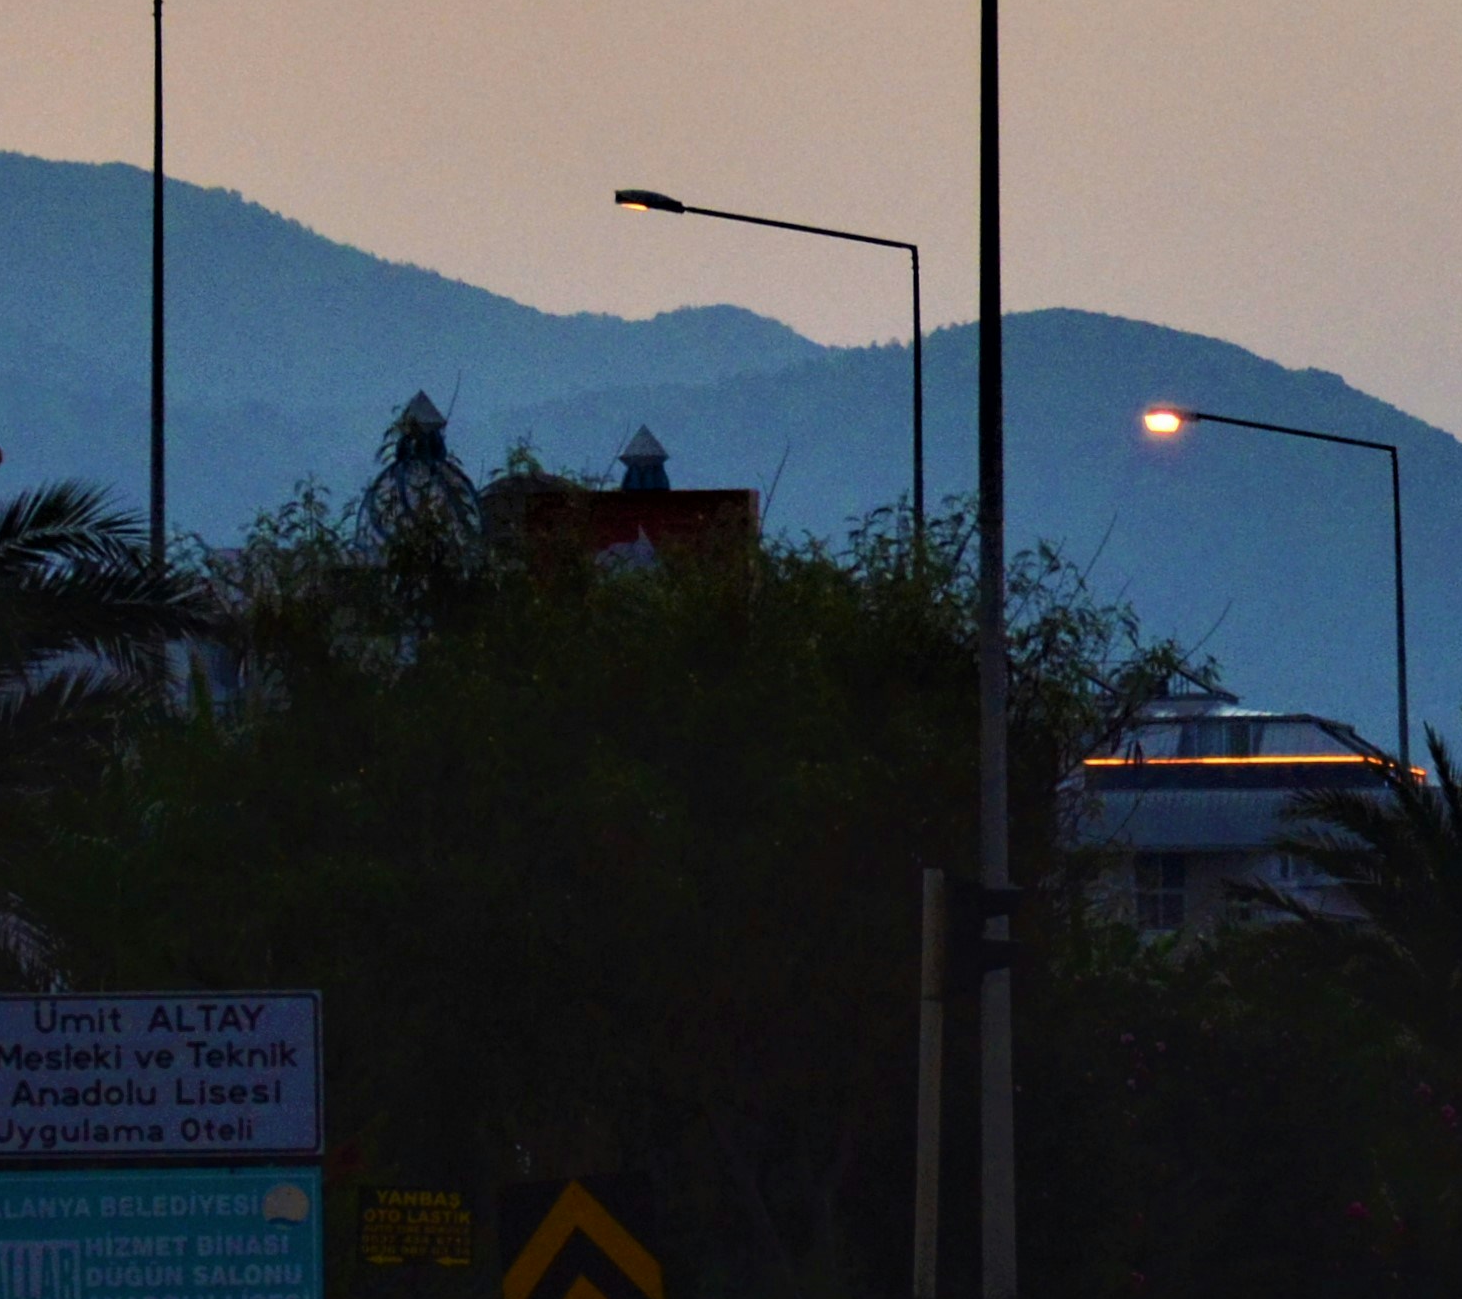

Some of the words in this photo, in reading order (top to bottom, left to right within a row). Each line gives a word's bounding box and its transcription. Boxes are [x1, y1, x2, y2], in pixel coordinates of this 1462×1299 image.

[35, 1000, 121, 1034] Ümit
[148, 1004, 264, 1033] ALTAY
[135, 1049, 175, 1069] ve
[187, 1040, 298, 1069] Teknik
[11, 1079, 157, 1107] Anadolu
[176, 1078, 281, 1105] Lisesi
[180, 1117, 253, 1142] Oteli
[100, 1188, 258, 1217] BELEDİYESİ
[364, 1208, 402, 1222] OTO
[84, 1232, 188, 1258] HİZMET
[197, 1232, 290, 1255] BİNASI
[85, 1261, 184, 1287] DÜĞÜN
[193, 1263, 302, 1286] SALONU
